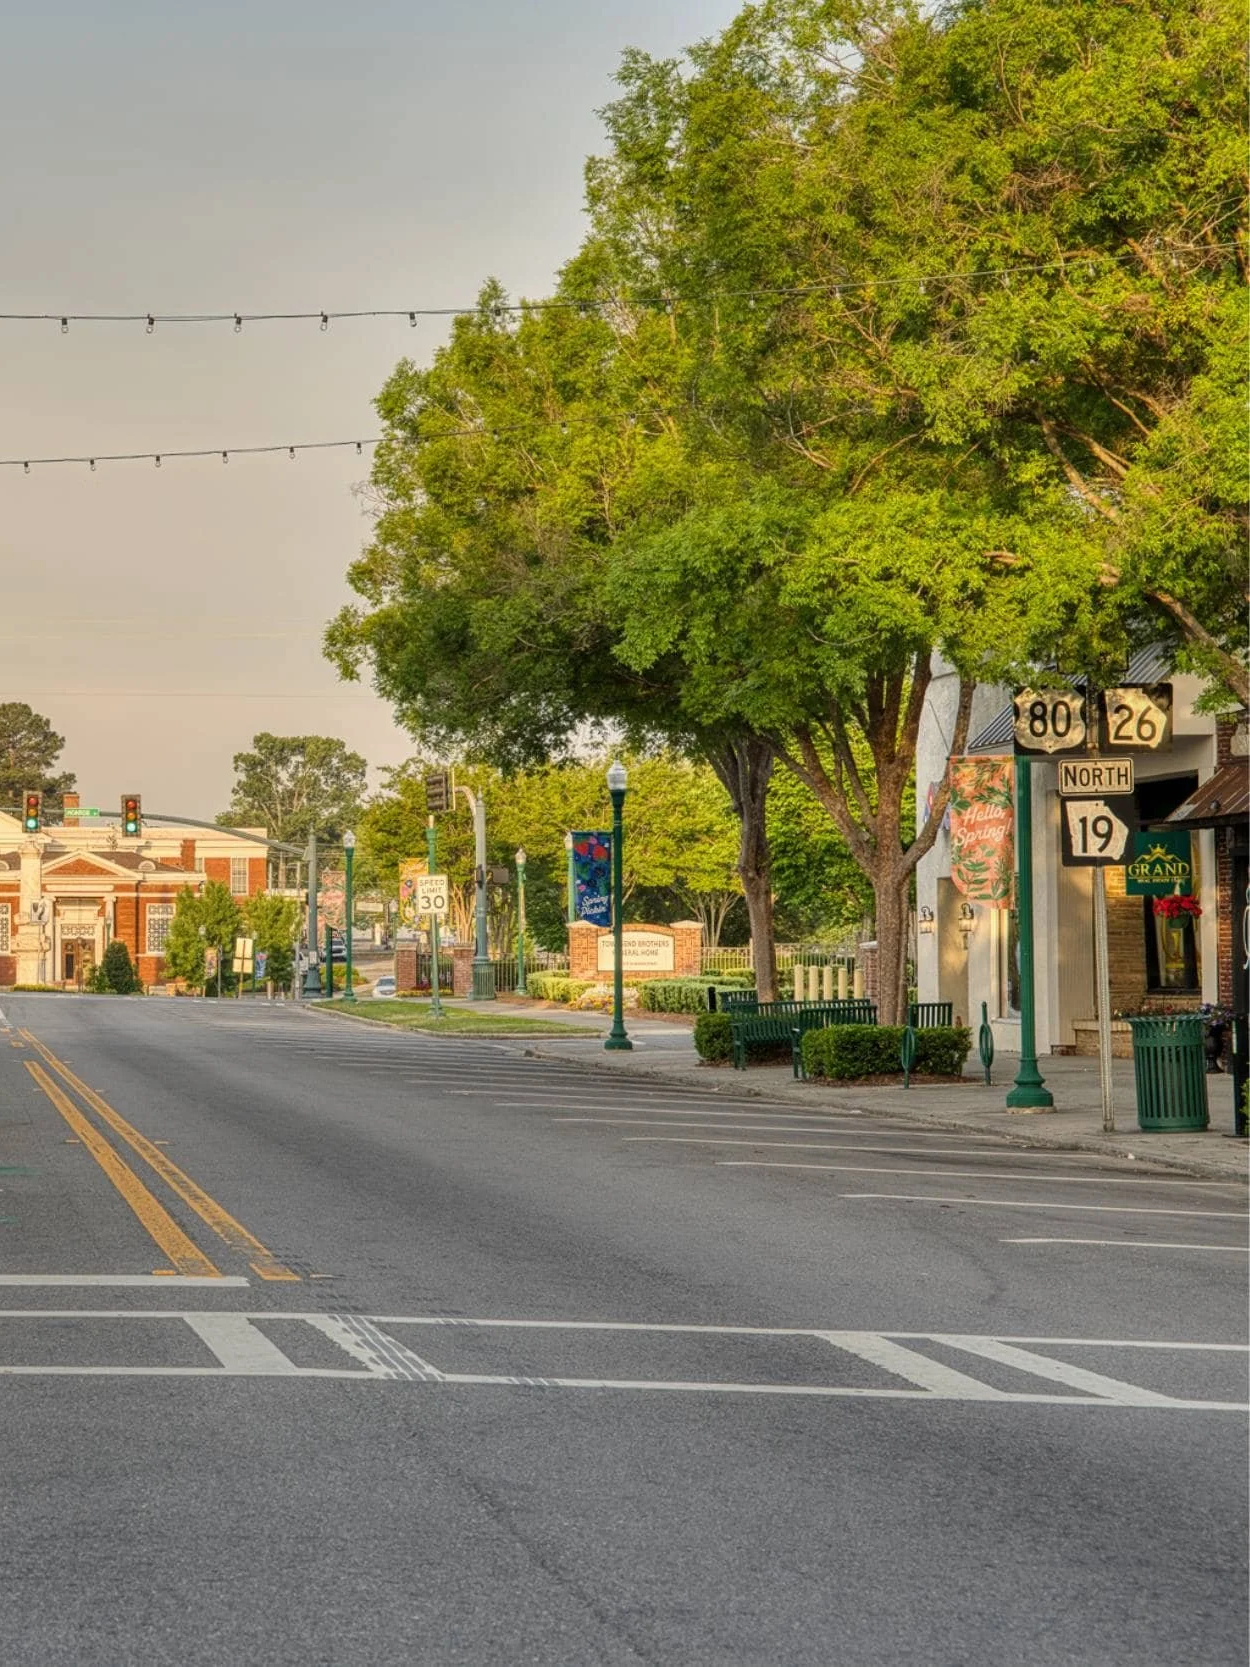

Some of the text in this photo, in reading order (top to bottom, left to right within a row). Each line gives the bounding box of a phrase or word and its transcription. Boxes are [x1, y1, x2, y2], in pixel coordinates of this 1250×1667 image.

[1029, 700, 1071, 738] 80
[1113, 703, 1157, 742] 26
[1063, 765, 1129, 787] NORTH
[963, 804, 1006, 826] Hello,
[953, 817, 1013, 849] Spring!
[1078, 815, 1114, 854] 19
[1128, 863, 1190, 877] GRAND
[421, 895, 445, 910] 30
